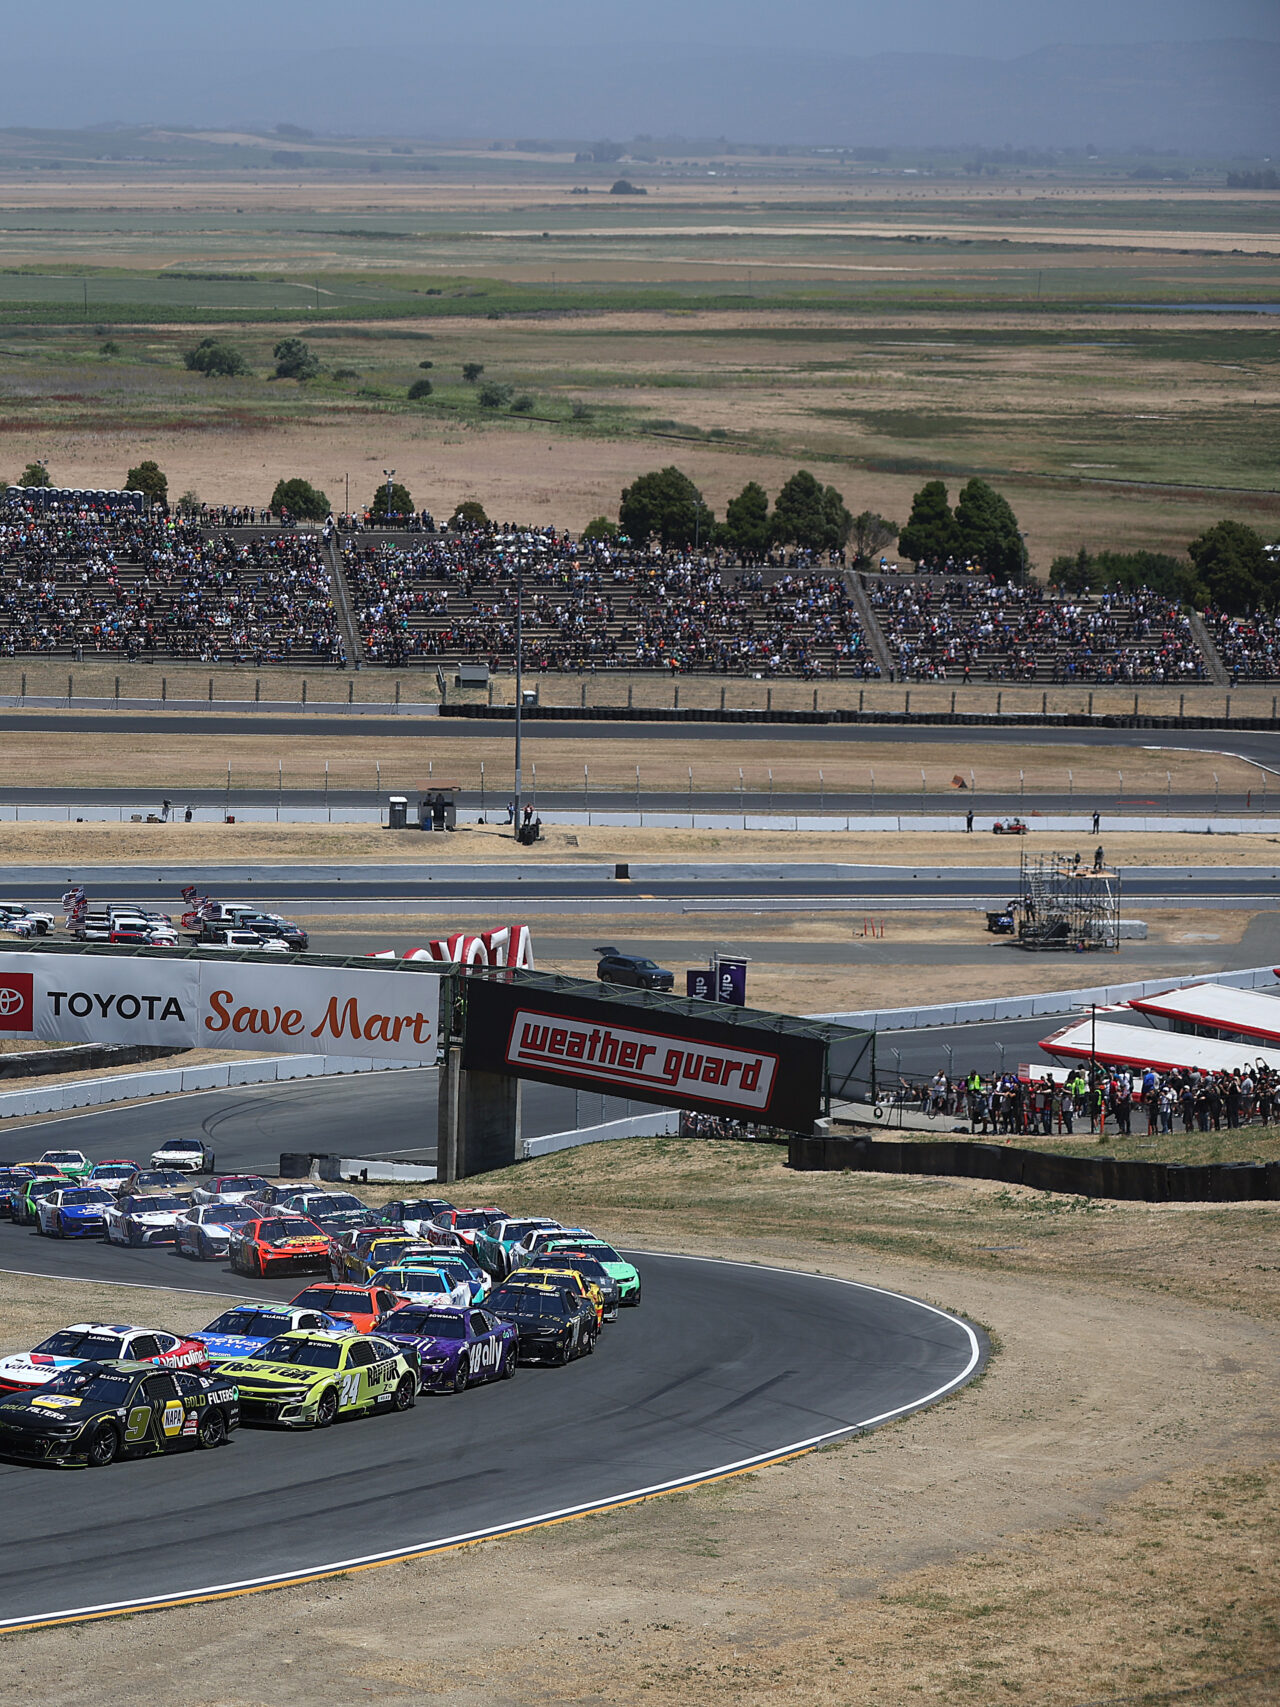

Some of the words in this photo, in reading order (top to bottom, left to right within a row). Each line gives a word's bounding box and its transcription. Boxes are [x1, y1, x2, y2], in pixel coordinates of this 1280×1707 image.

[720, 974, 733, 999] ally
[47, 992, 185, 1022] TOYOTA
[204, 990, 305, 1036] Save
[311, 996, 431, 1044] Mart
[519, 1022, 657, 1071] weather
[663, 1048, 763, 1092] guard
[160, 1350, 203, 1368] Valvoline
[482, 1335, 503, 1373] ally
[4, 1363, 62, 1375] Valvolin
[222, 1362, 318, 1381] RAPTOR
[366, 1359, 400, 1387] RAPTOR
[184, 1394, 206, 1408] GOLD
[208, 1389, 234, 1405] FILTERS
[340, 1373, 361, 1406] 24
[25, 1406, 67, 1420] FILTERS
[124, 1406, 152, 1441] 9
[165, 1408, 180, 1426] NAPA
